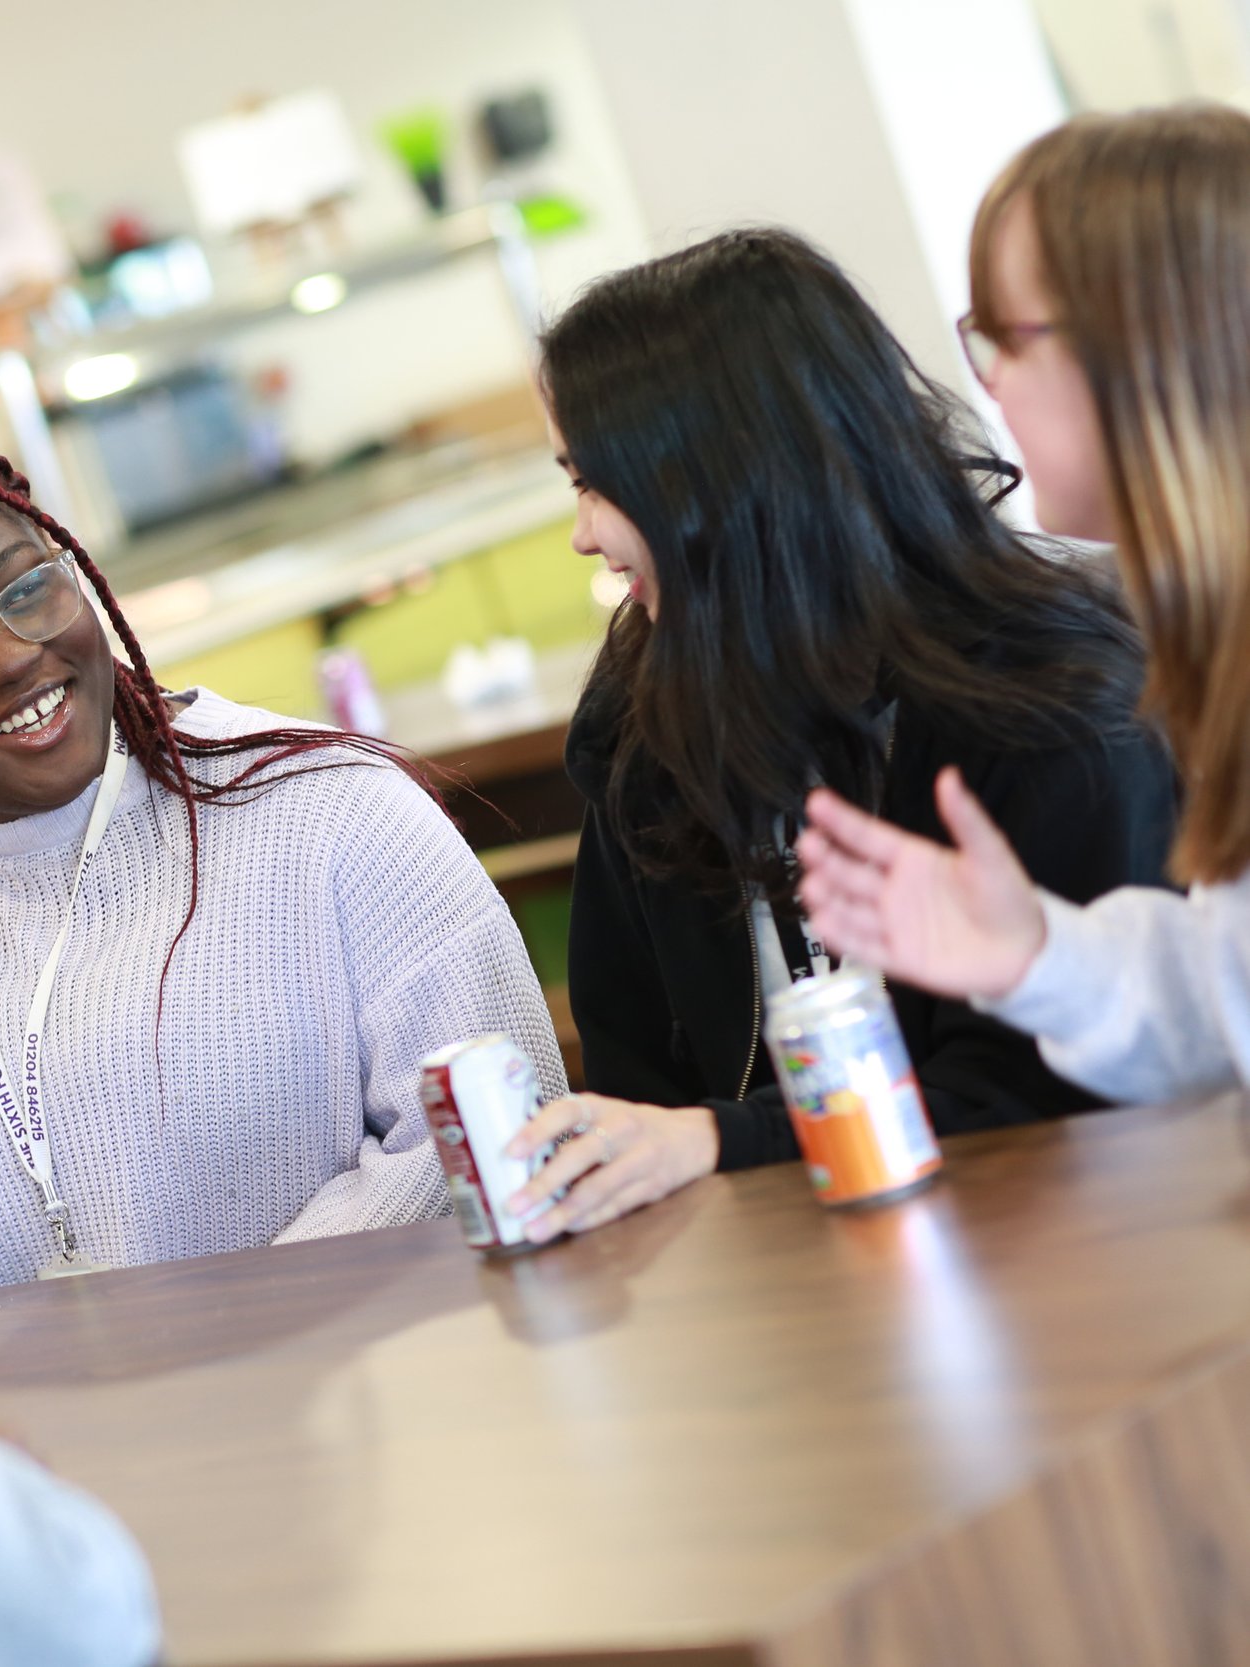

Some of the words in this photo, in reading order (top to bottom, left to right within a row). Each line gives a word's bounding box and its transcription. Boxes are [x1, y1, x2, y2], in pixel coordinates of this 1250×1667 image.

[25, 1033, 38, 1082] 01204
[0, 1091, 27, 1139] SIXTH
[26, 1086, 45, 1141] 846215
